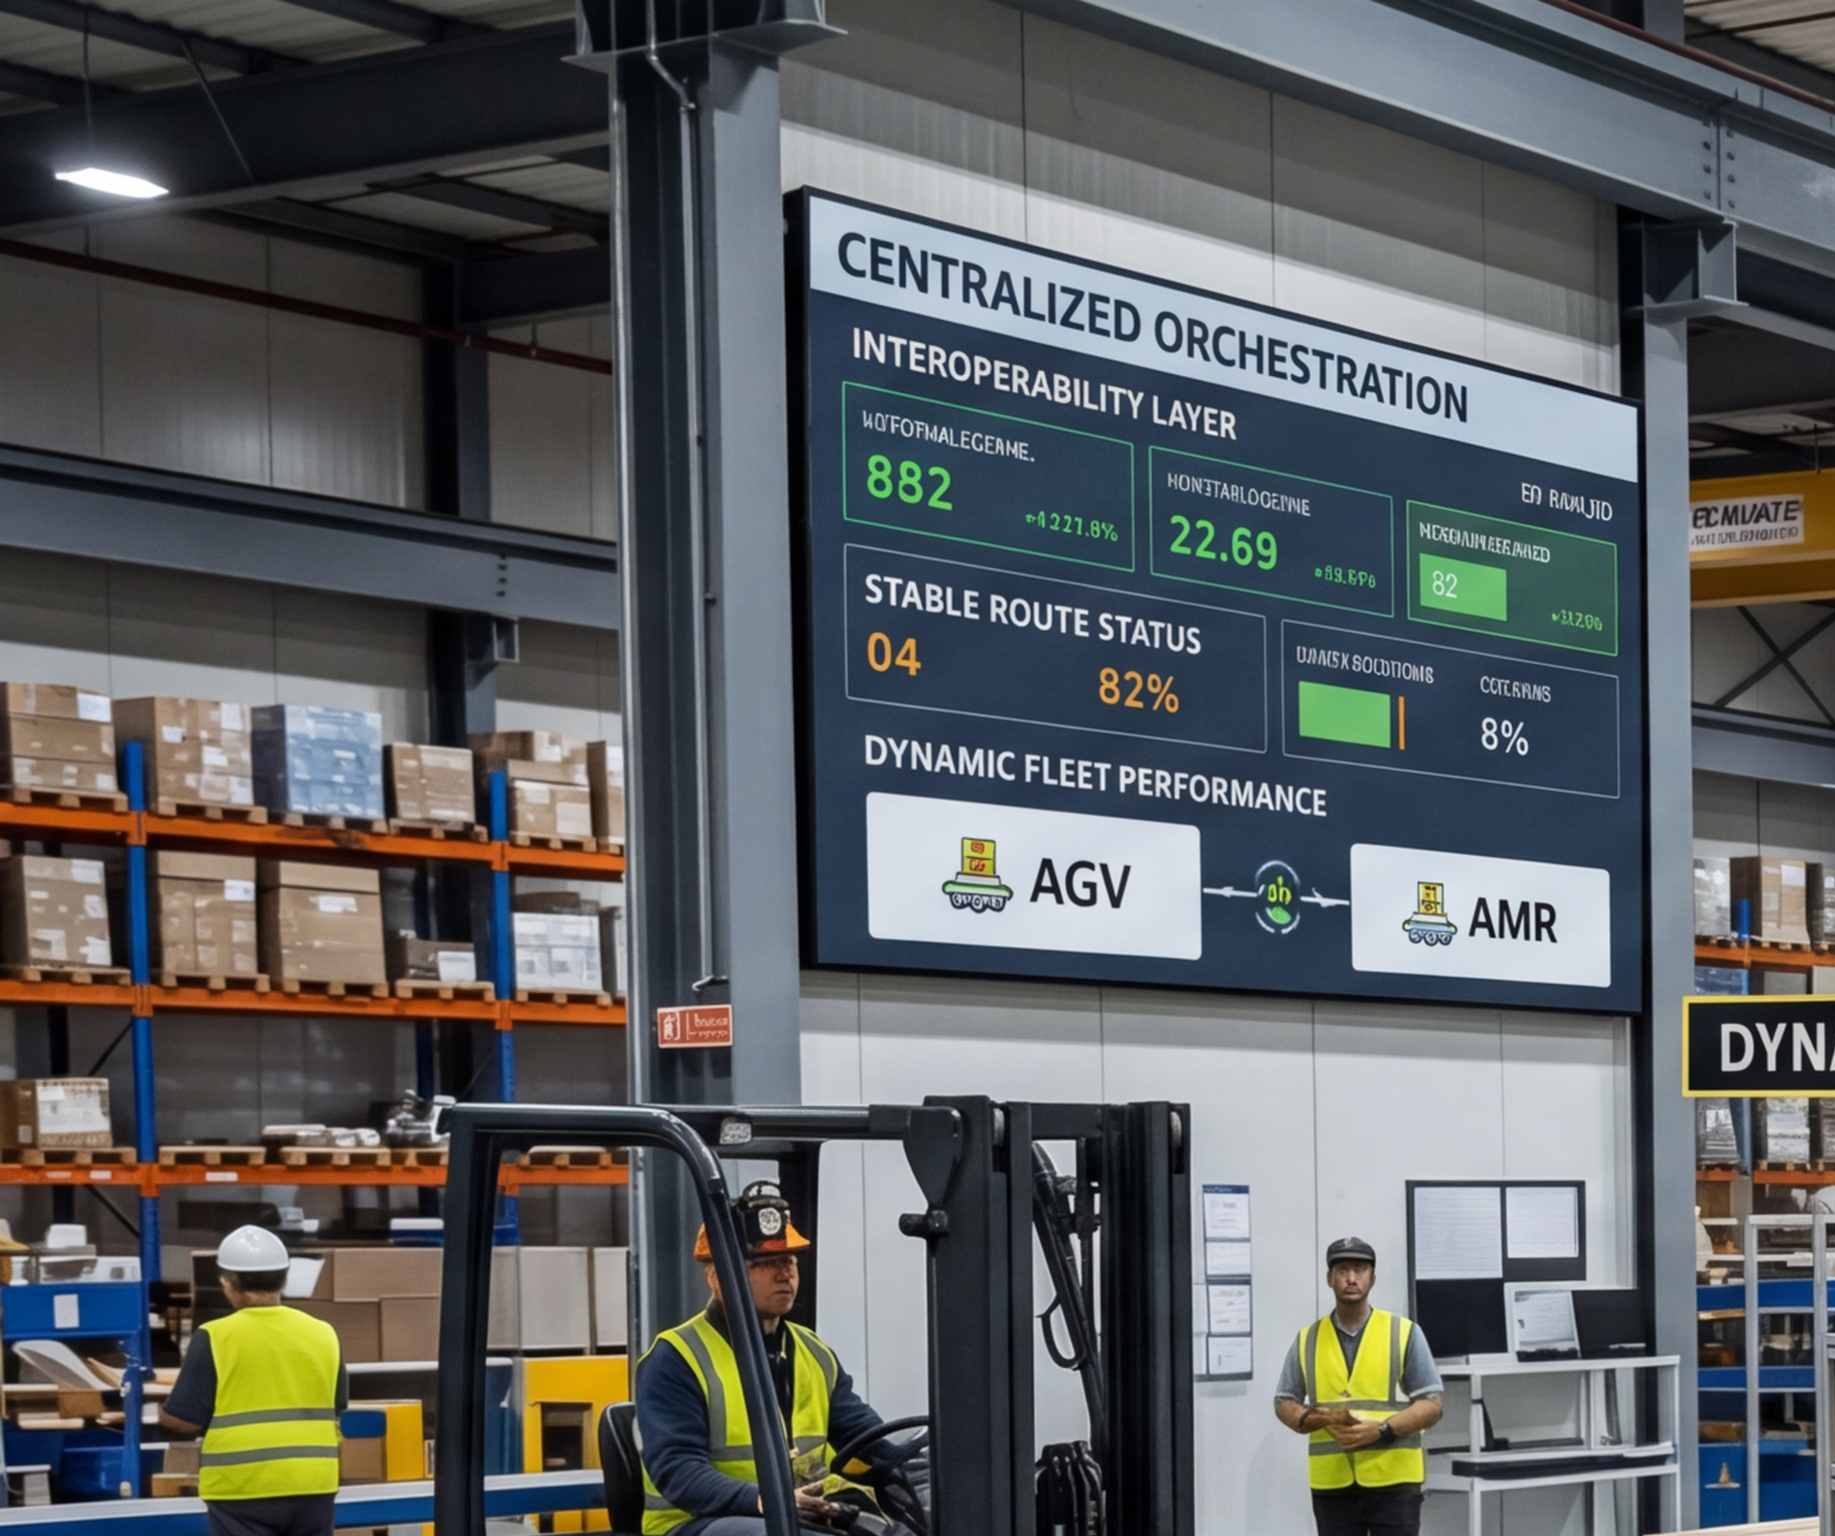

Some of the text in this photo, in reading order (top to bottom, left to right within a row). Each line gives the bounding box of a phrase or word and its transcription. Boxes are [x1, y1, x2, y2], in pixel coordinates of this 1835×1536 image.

[838, 232, 1468, 423] CENTRALIZED ORCHESTRATION
[853, 326, 1237, 440] INTEROPERABILITY LAYER
[866, 454, 952, 511] 882
[1170, 515, 1278, 570] 22.69
[1432, 571, 1457, 598] 82
[865, 574, 1201, 655] STABLE ROUTE STATUS
[867, 632, 922, 677] 04
[1098, 667, 1179, 713] 82%
[1481, 717, 1528, 756] 8%
[864, 734, 1327, 817] DYNAMIC FLEET PERFORMANCE
[1030, 858, 1131, 909] AGV
[1469, 896, 1558, 944] AMR
